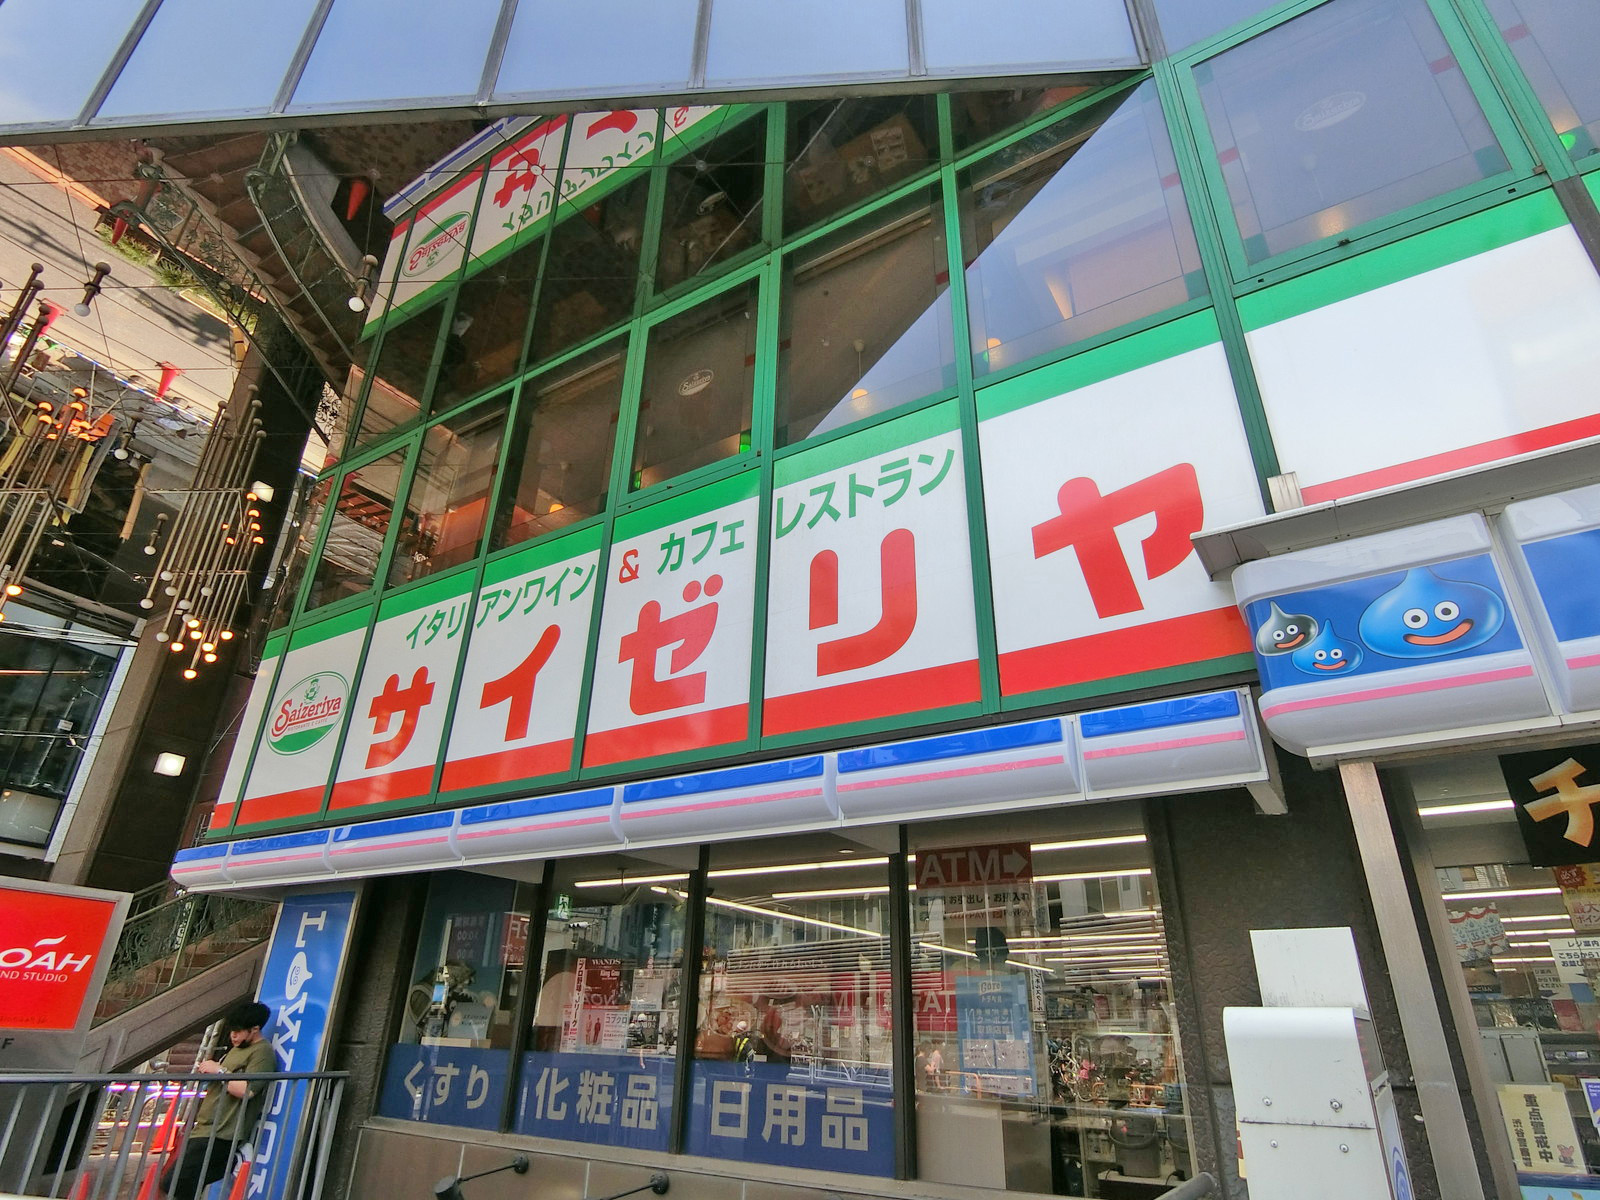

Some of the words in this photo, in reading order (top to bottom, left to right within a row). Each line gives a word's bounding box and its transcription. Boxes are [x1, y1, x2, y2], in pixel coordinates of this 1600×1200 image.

[618, 549, 640, 584] &
[365, 462, 1204, 770] サイゼリヤ
[271, 695, 342, 737] Saizeriya
[1522, 757, 1600, 847] チ
[920, 849, 1001, 886] ATM
[23, 971, 68, 983] STUDIO
[404, 1061, 490, 1110] くすり
[535, 1067, 659, 1130] 化粧品
[711, 1080, 869, 1151] 日用品
